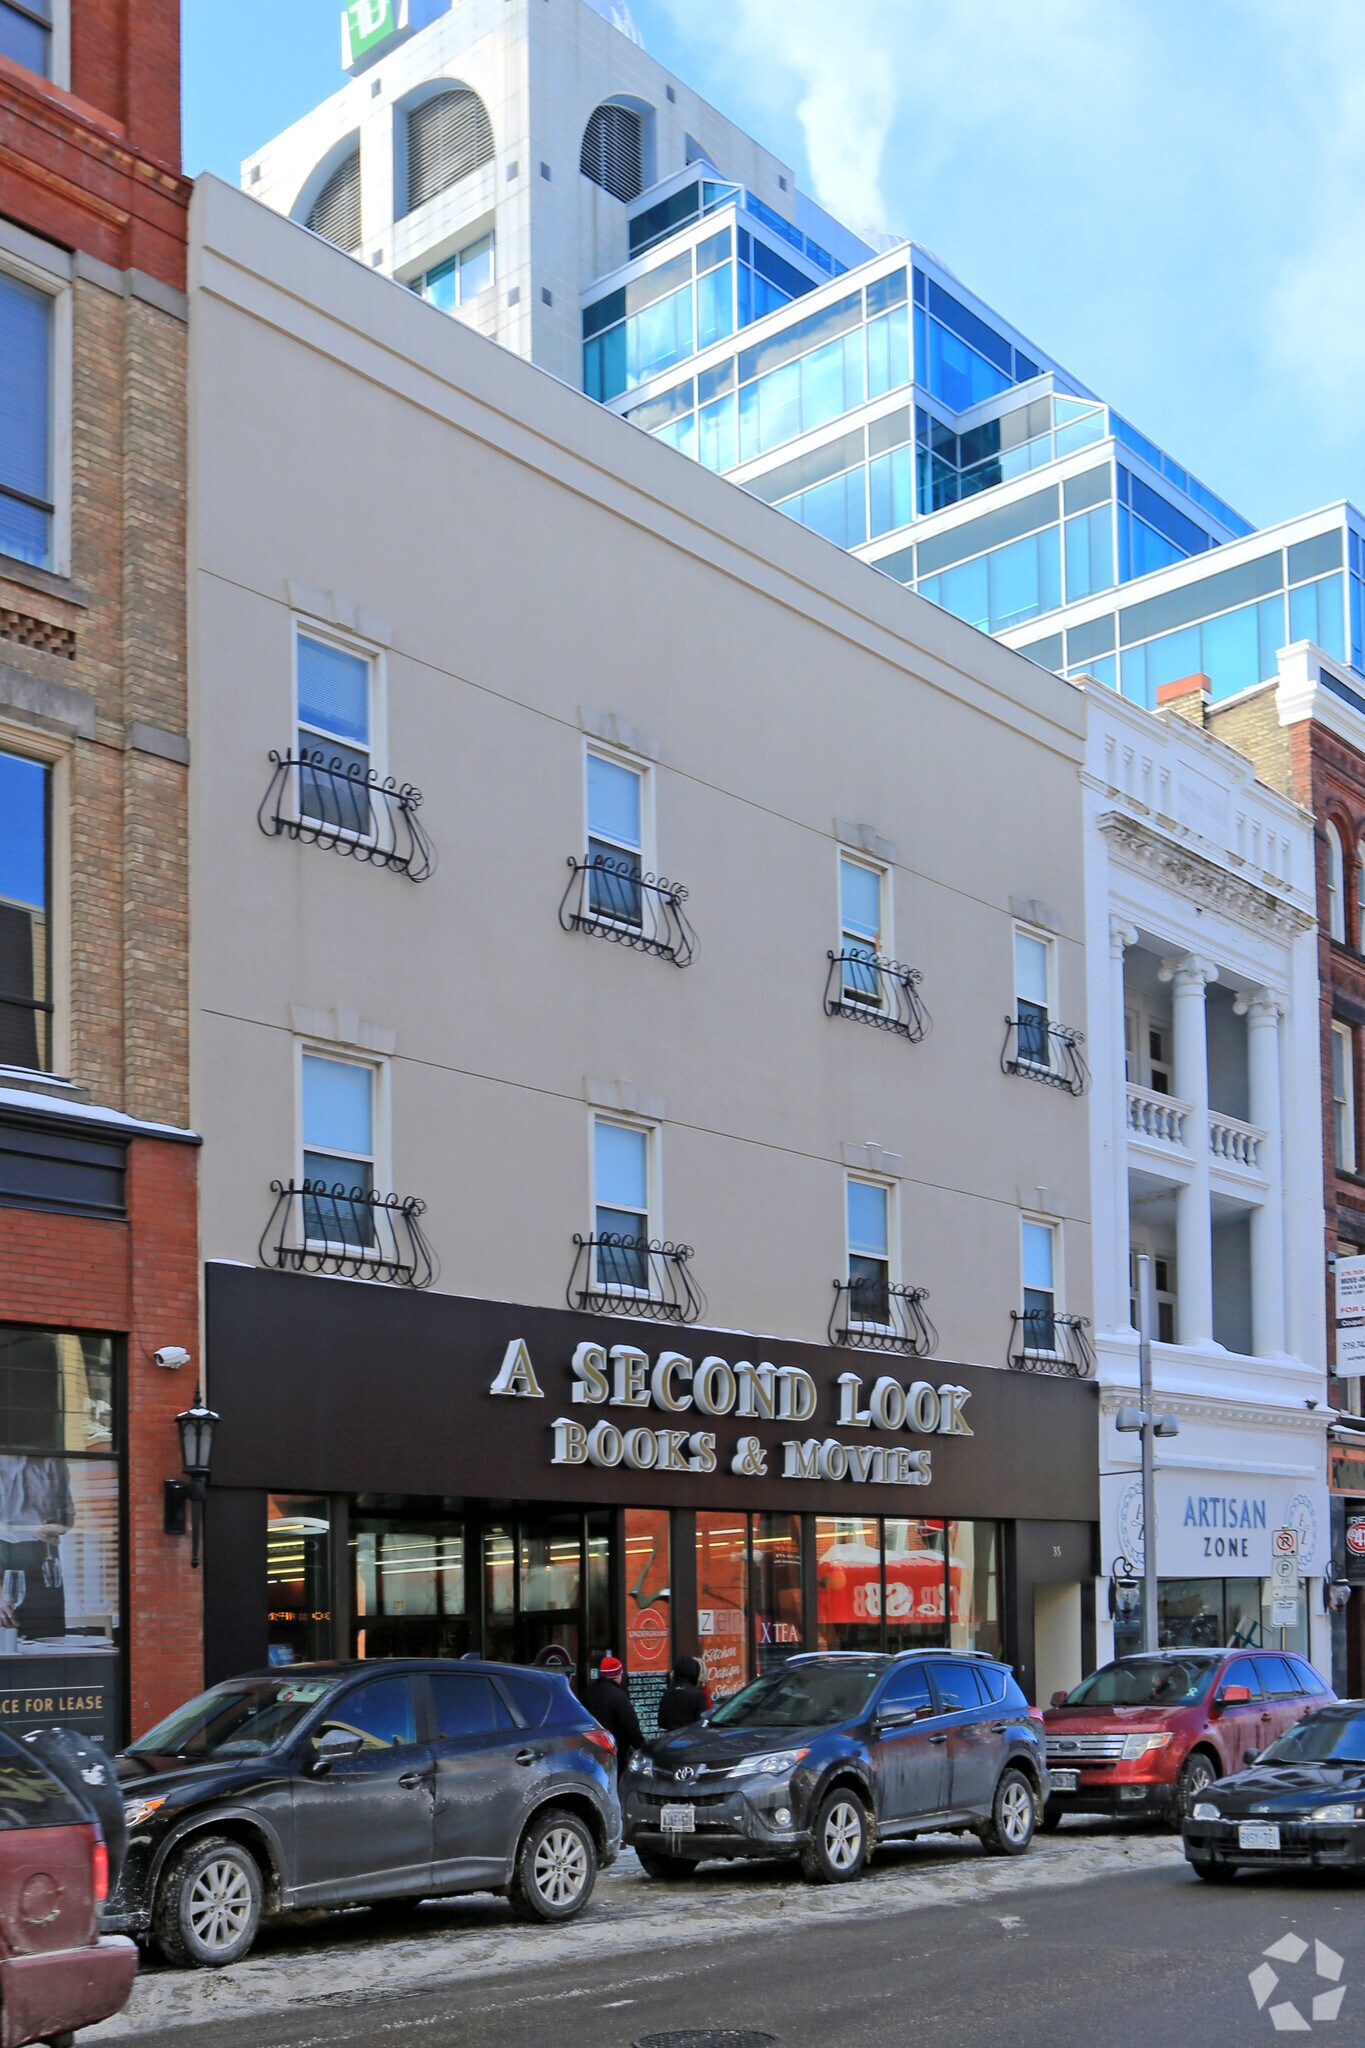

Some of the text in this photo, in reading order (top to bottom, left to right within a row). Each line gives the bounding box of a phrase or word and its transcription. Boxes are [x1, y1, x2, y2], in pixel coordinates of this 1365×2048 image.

[490, 1338, 974, 1436] A SECOND LOOK
[551, 1417, 932, 1486] BOOKS & MOVIES
[1184, 1496, 1266, 1529] ARTISAN
[1204, 1537, 1249, 1557] ZONE
[629, 1629, 668, 1638] UNDERGROUND
[703, 1645, 737, 1663] Kitchen
[707, 1664, 740, 1683] Design
[25, 1698, 53, 1713] FOR
[59, 1695, 103, 1711] LEASE
